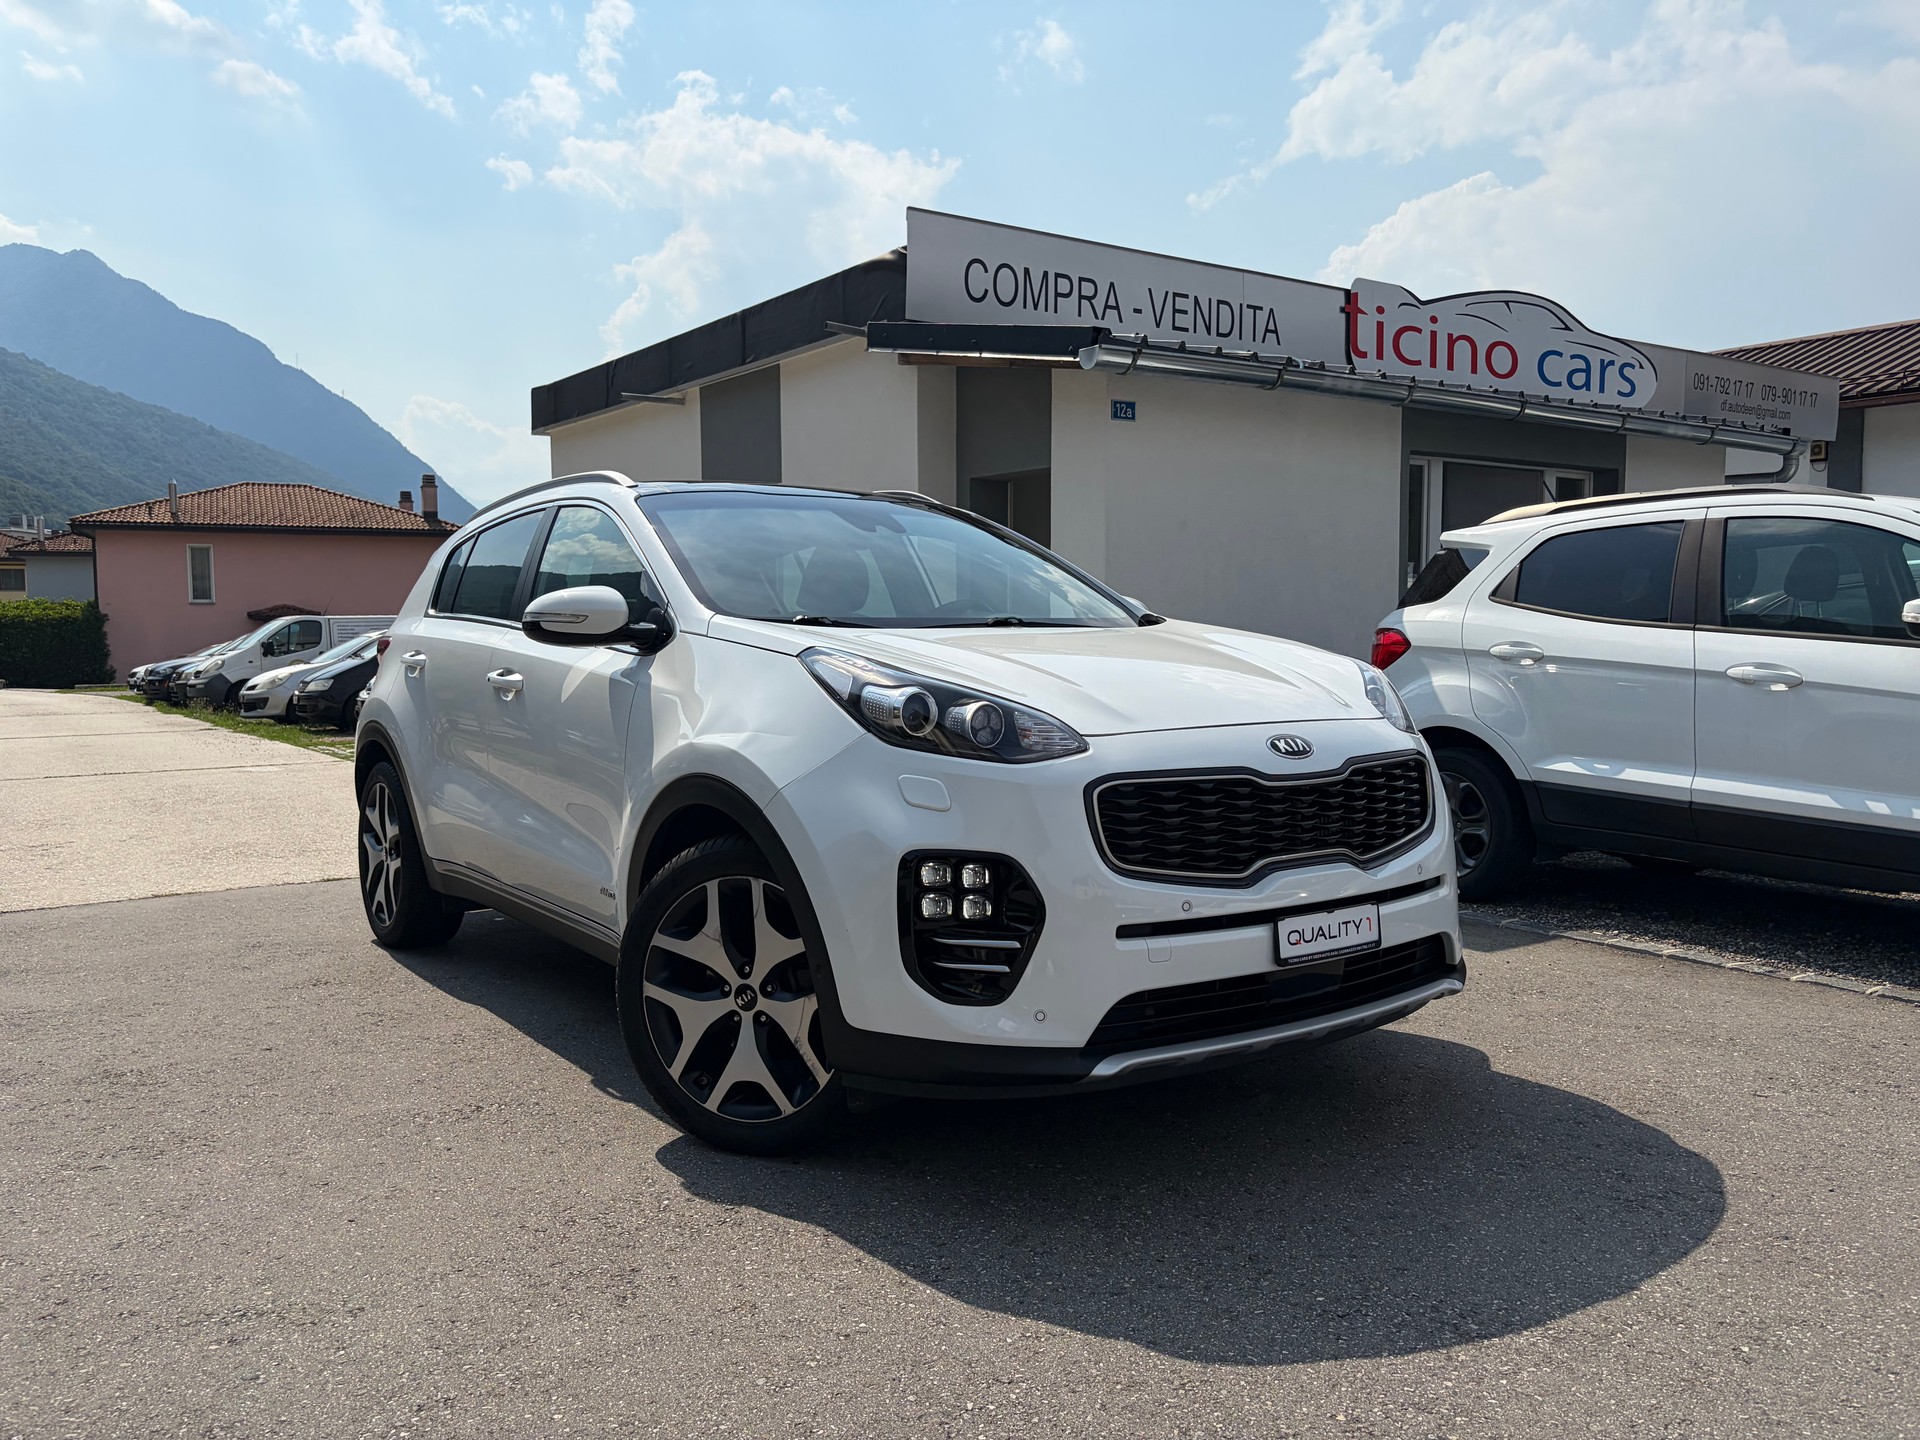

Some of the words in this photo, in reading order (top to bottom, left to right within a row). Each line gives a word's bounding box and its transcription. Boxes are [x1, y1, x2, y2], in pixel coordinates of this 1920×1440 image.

[964, 258, 1123, 324] COMPRA
[1344, 292, 1519, 379] ticino
[1537, 349, 1637, 398] cars
[1115, 403, 1132, 418] 12a
[1272, 738, 1311, 753] KIA
[1287, 917, 1363, 946] QUALITY
[735, 989, 755, 1007] KIA
